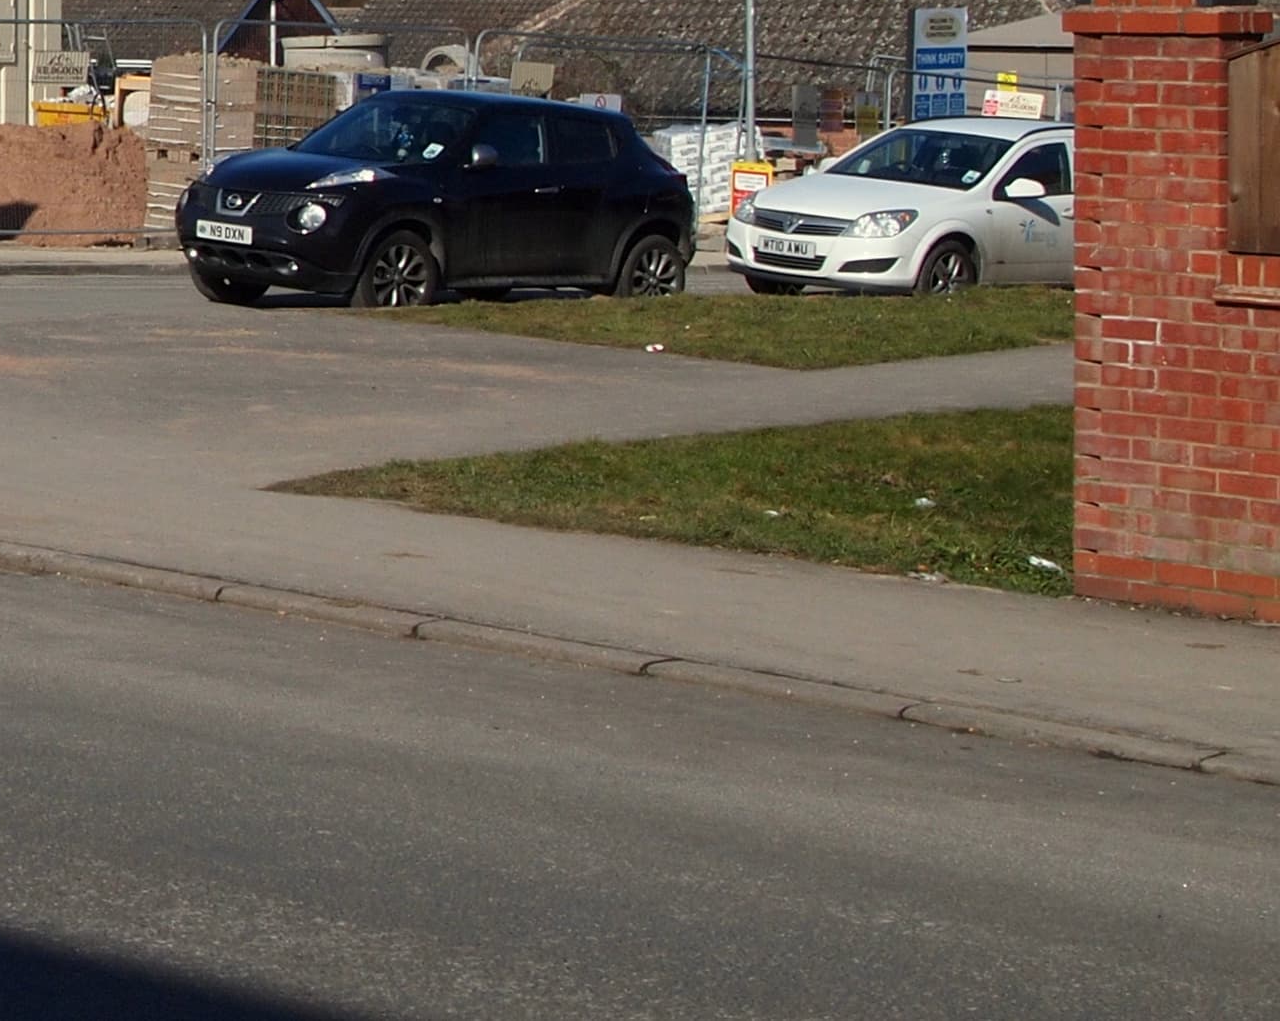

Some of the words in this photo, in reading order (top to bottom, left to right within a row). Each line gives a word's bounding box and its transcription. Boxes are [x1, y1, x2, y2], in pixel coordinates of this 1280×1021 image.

[938, 52, 964, 65] SAFETY
[210, 225, 221, 236] N9
[224, 227, 245, 241] DXN
